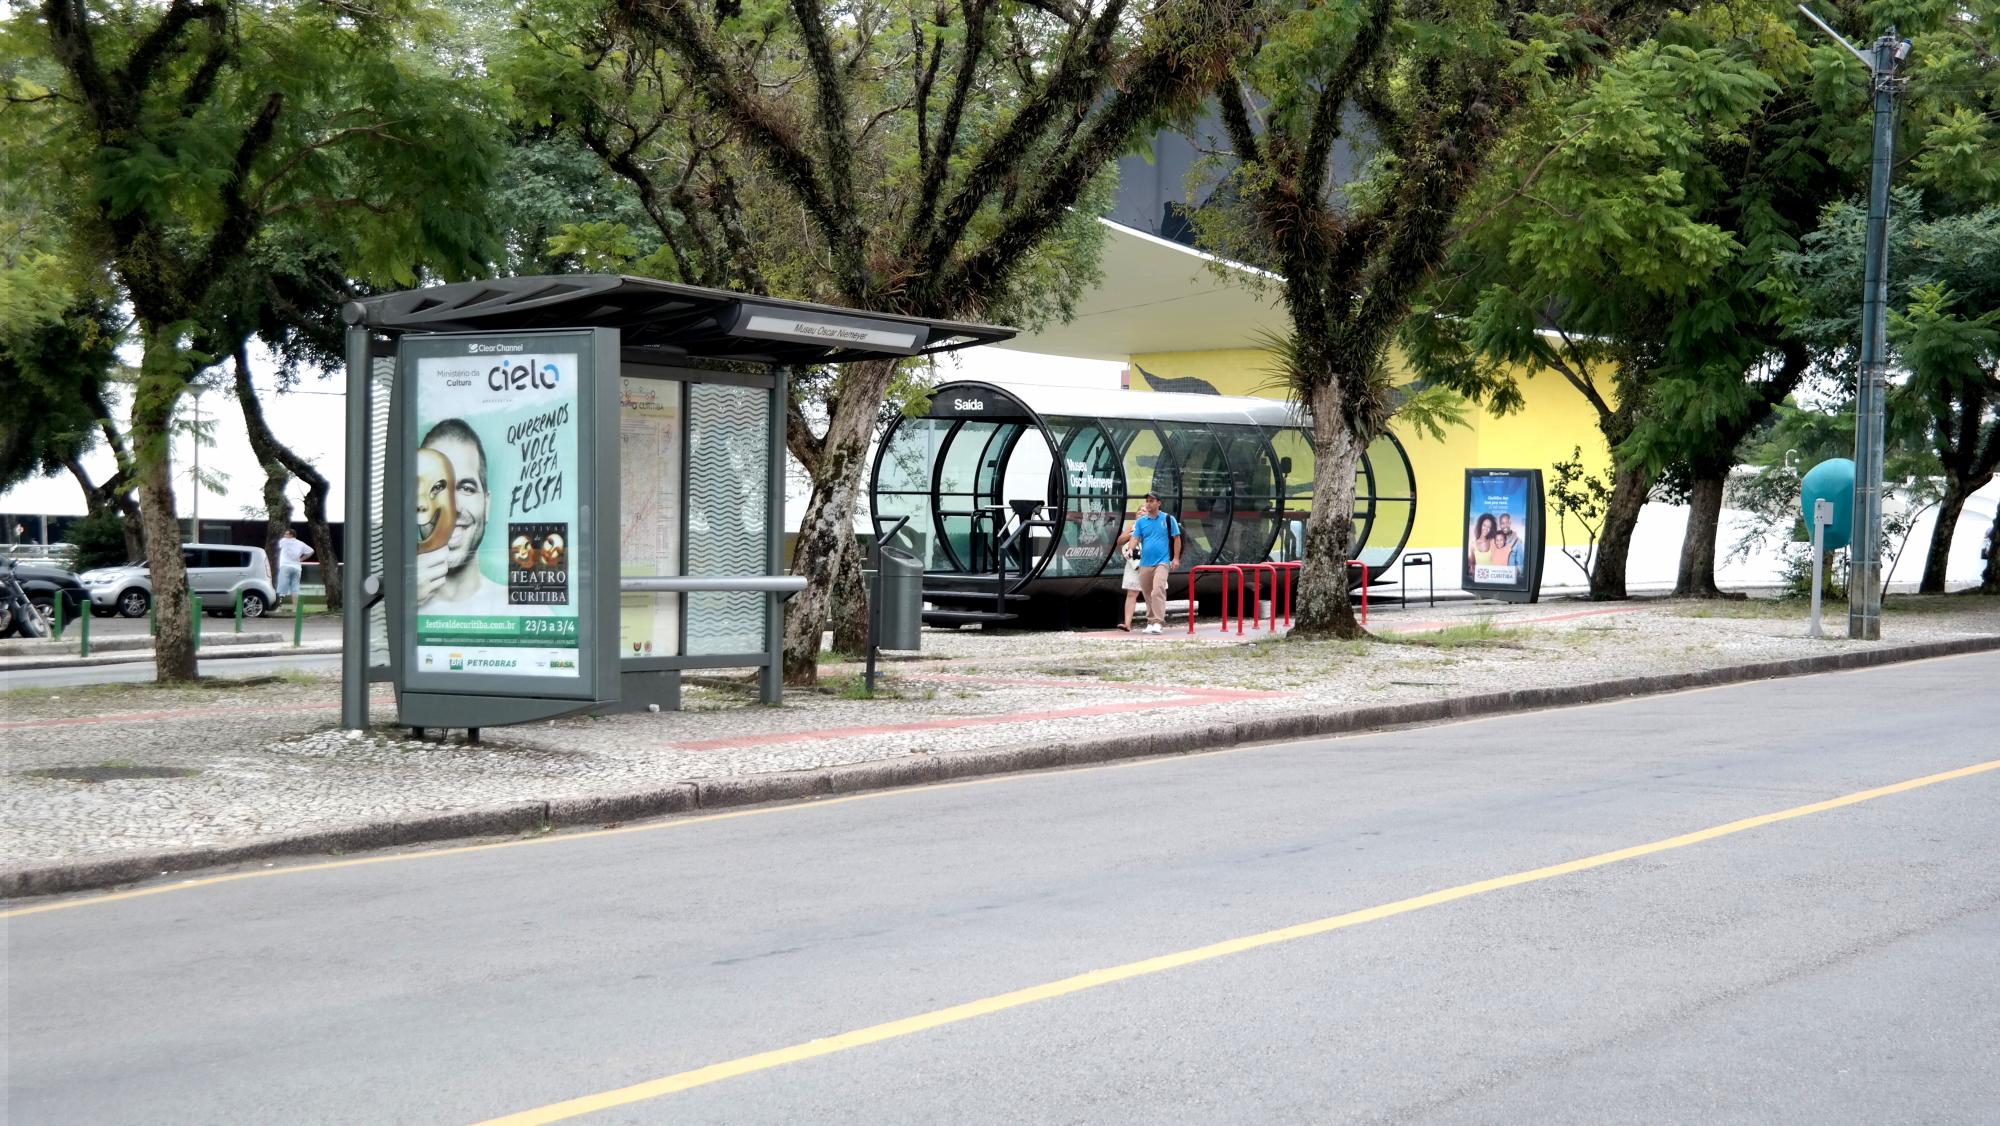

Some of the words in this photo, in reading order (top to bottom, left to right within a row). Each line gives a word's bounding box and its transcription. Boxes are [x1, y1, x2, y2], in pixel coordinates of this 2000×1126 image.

[794, 323, 817, 335] Museu
[817, 326, 837, 337] Oscar
[837, 329, 868, 341] Niemeyer
[478, 344, 496, 352] Clear
[496, 344, 523, 352] Channel
[488, 359, 559, 391] cielo
[446, 379, 472, 387] Cultura
[954, 398, 984, 411] Saída
[1067, 458, 1088, 472] Museu
[1070, 473, 1087, 488] Oscar
[1087, 474, 1113, 492] Niemeyer
[1065, 547, 1099, 558] CURITIBA
[511, 570, 566, 583] TEATRO
[511, 591, 566, 602] CURITIBA
[425, 619, 516, 630] festivaldecuritiba.com.br
[525, 620, 547, 635] 23/3
[549, 622, 556, 632] a
[557, 620, 575, 635] 3/4
[466, 659, 518, 667] PETROBRAS
